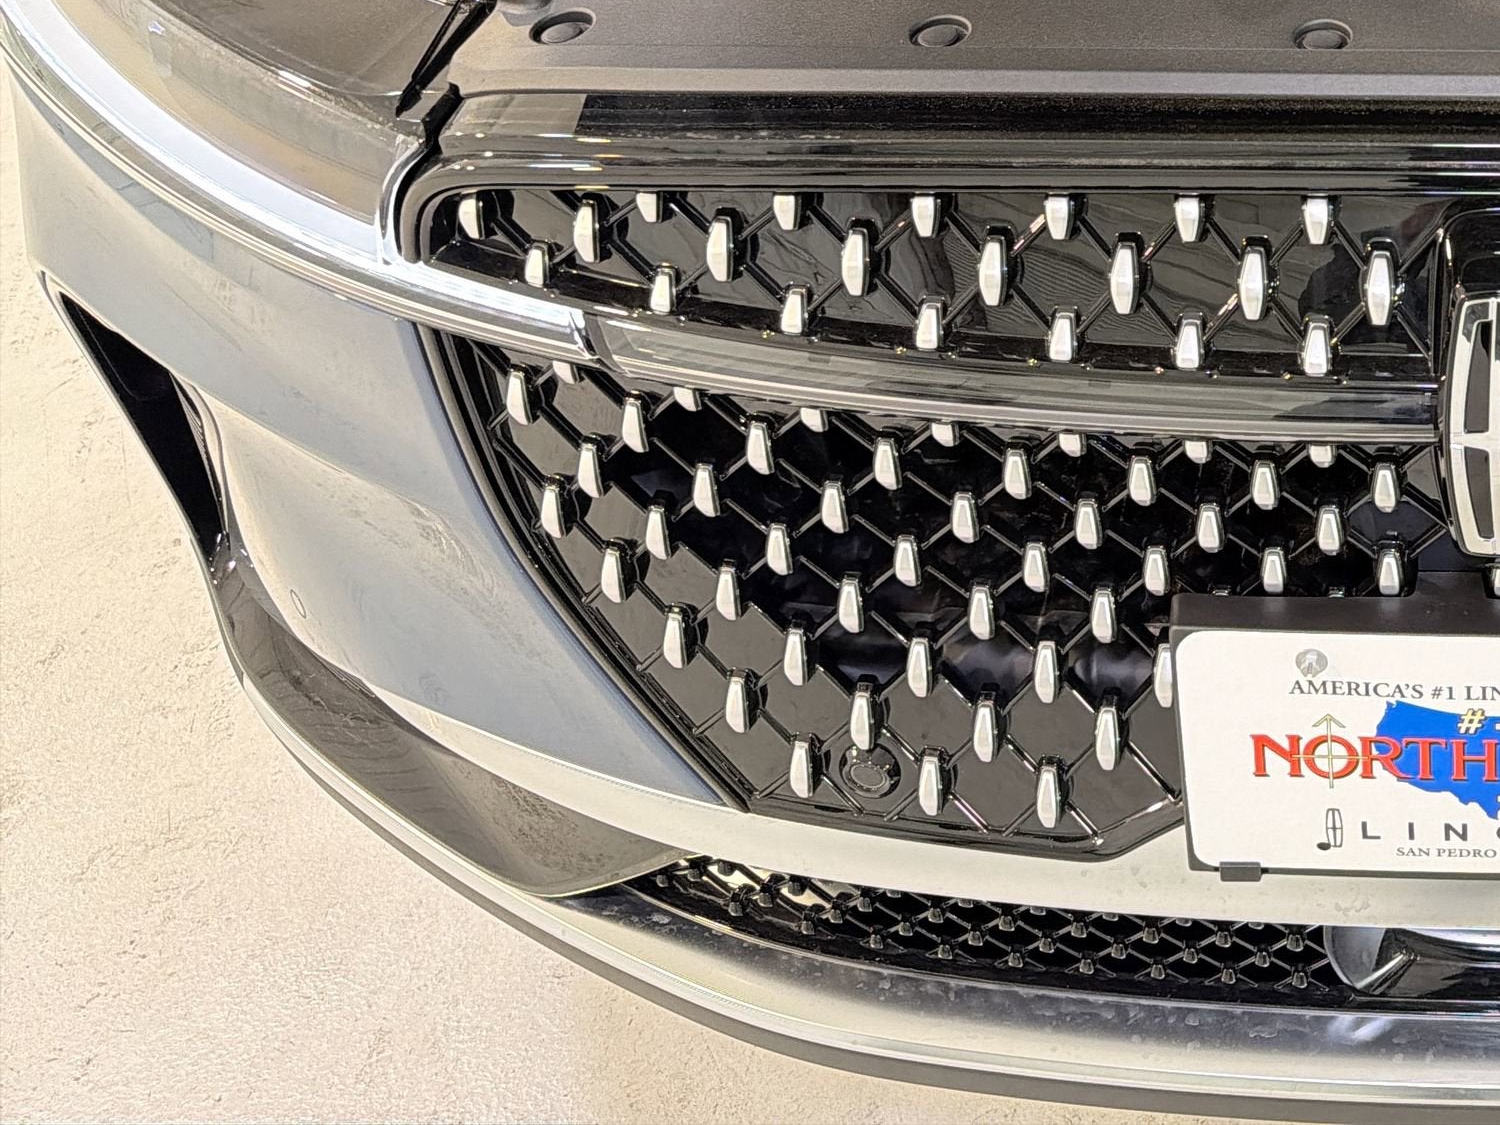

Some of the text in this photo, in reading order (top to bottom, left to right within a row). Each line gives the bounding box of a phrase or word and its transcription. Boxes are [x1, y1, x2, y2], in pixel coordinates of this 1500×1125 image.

[1289, 679, 1424, 699] AMERICA'S
[1431, 685, 1457, 700] #1
[1250, 733, 1500, 782] NORTH
[1395, 846, 1430, 858] SAN
[1436, 848, 1497, 859] PEDRO
